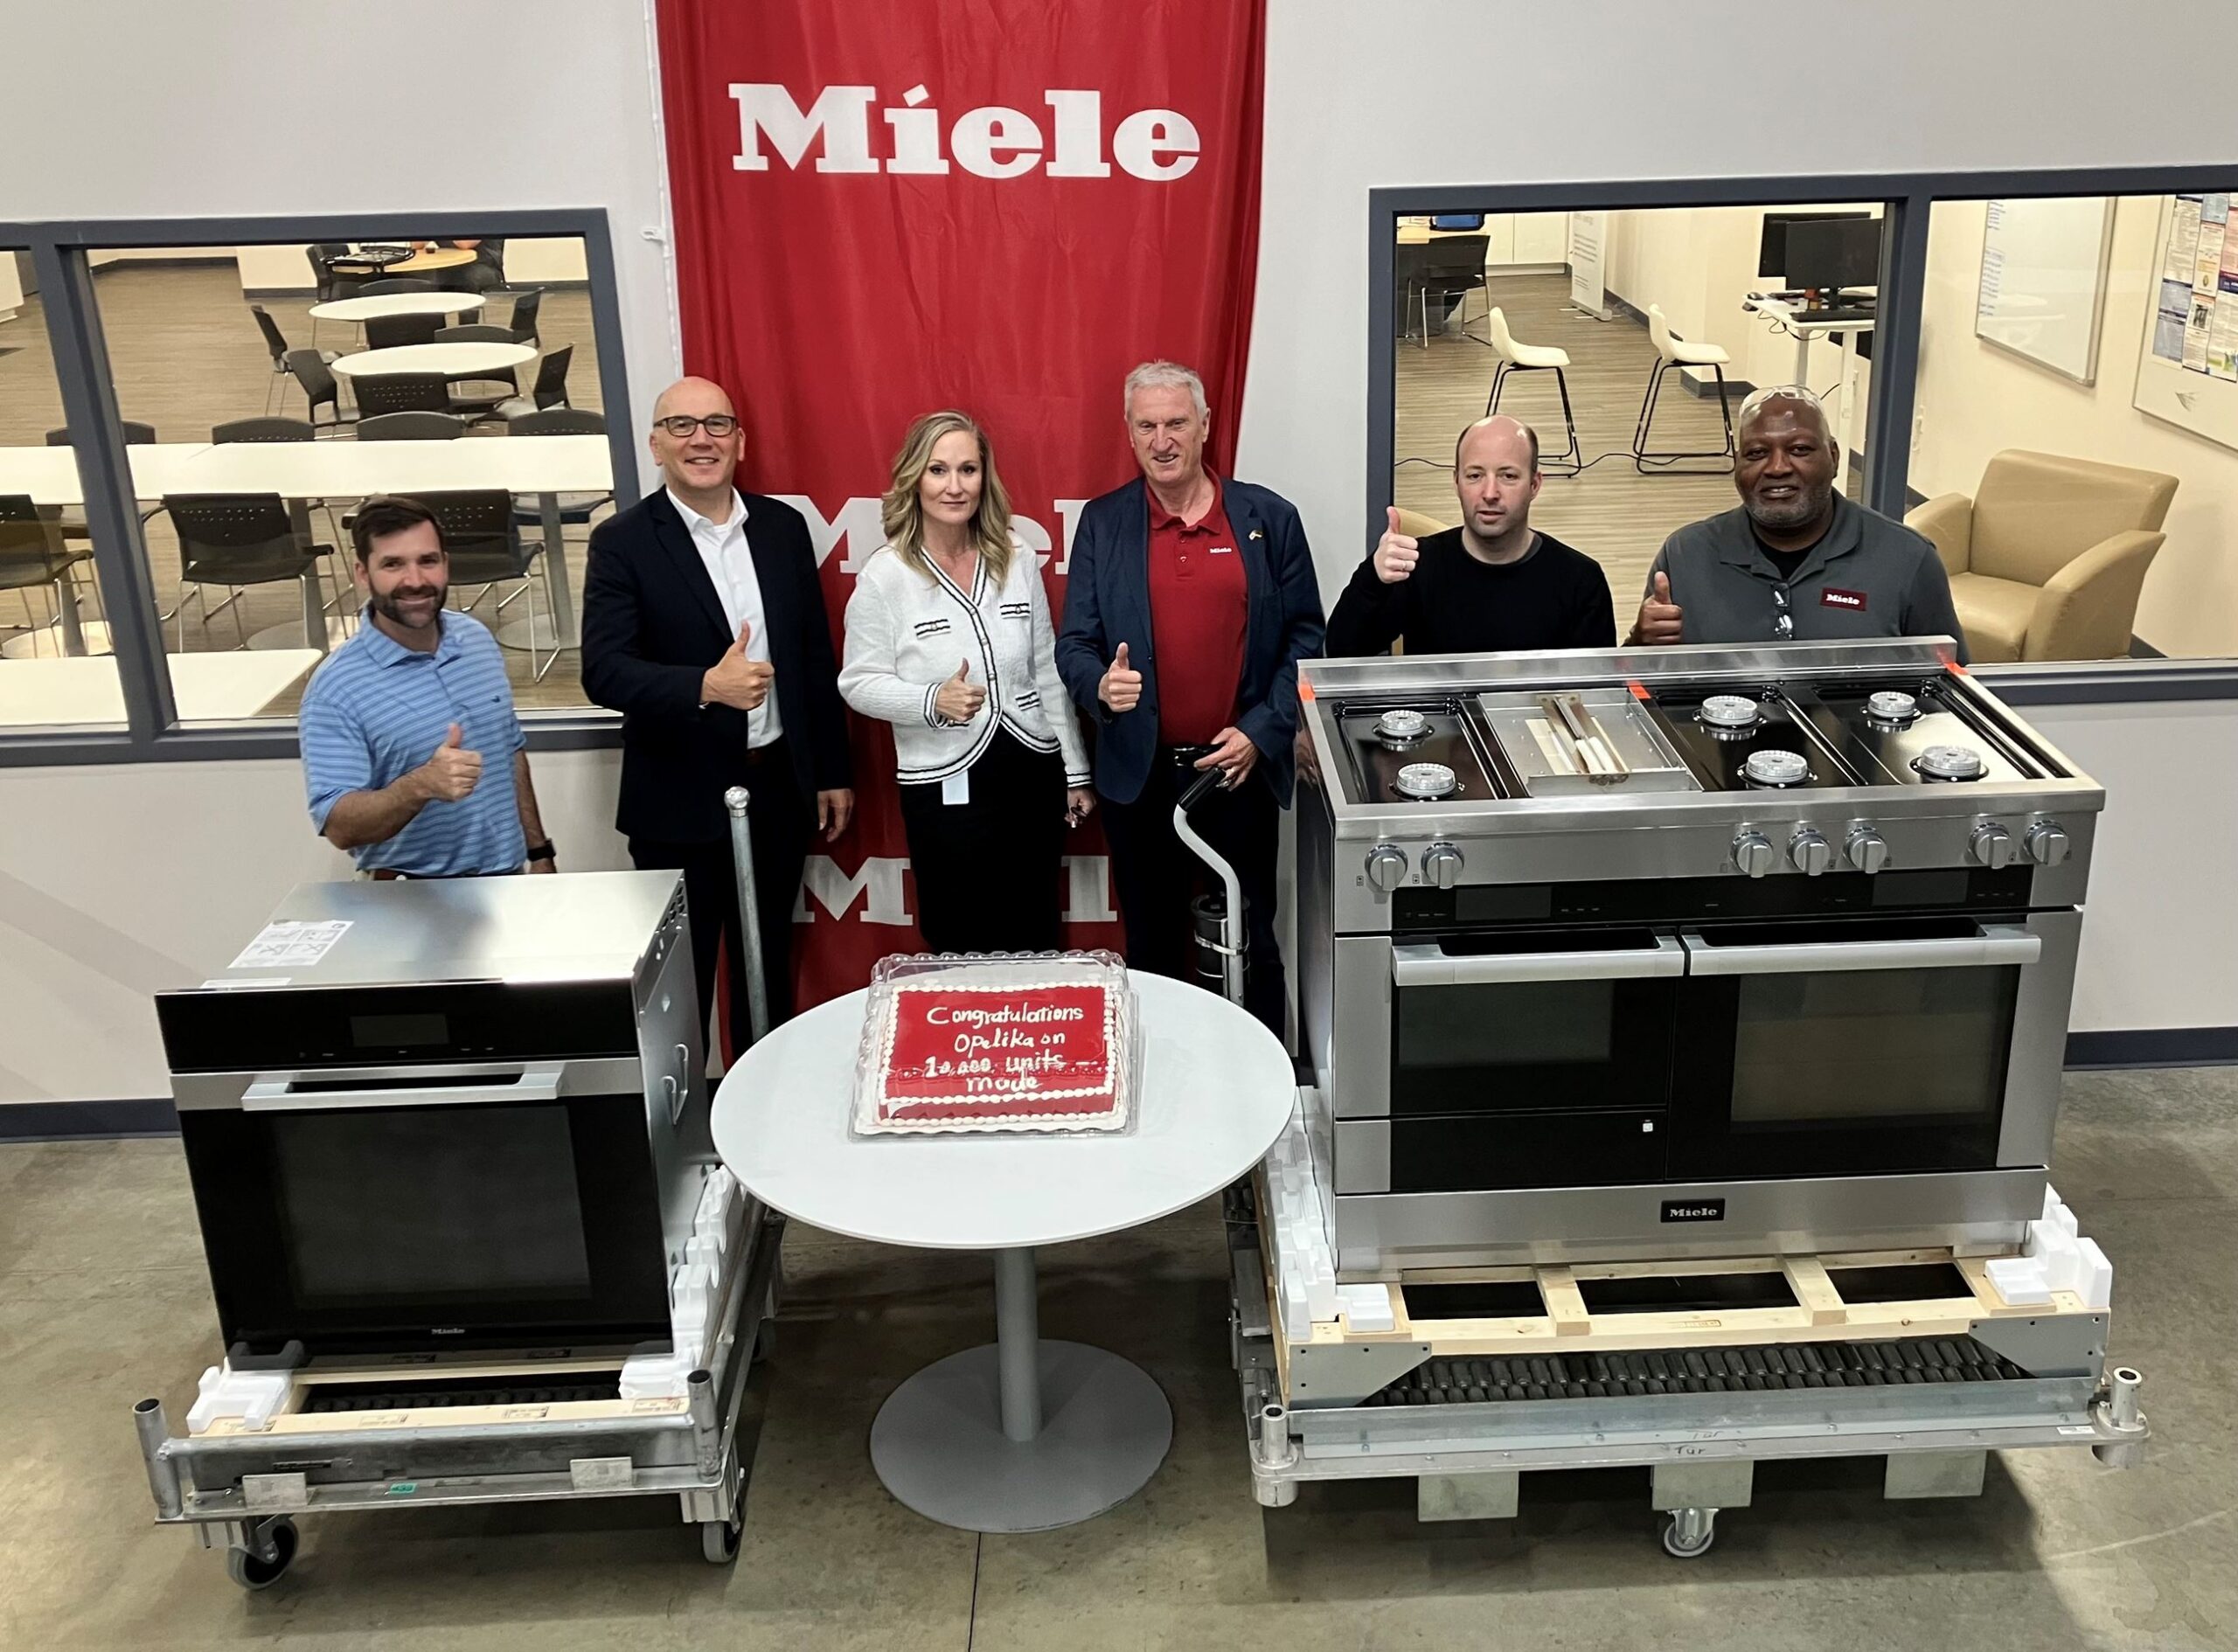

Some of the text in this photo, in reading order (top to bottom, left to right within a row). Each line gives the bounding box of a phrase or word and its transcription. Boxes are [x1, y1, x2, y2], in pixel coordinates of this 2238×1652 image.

[728, 83, 1201, 182] Miele
[1826, 593, 1859, 605] Miele
[926, 1002, 1084, 1030] Congratulations
[954, 1027, 1066, 1059] Opelika on
[1005, 1048, 1067, 1072] units
[966, 1068, 1042, 1093] made
[1669, 1207, 1718, 1218] Miele
